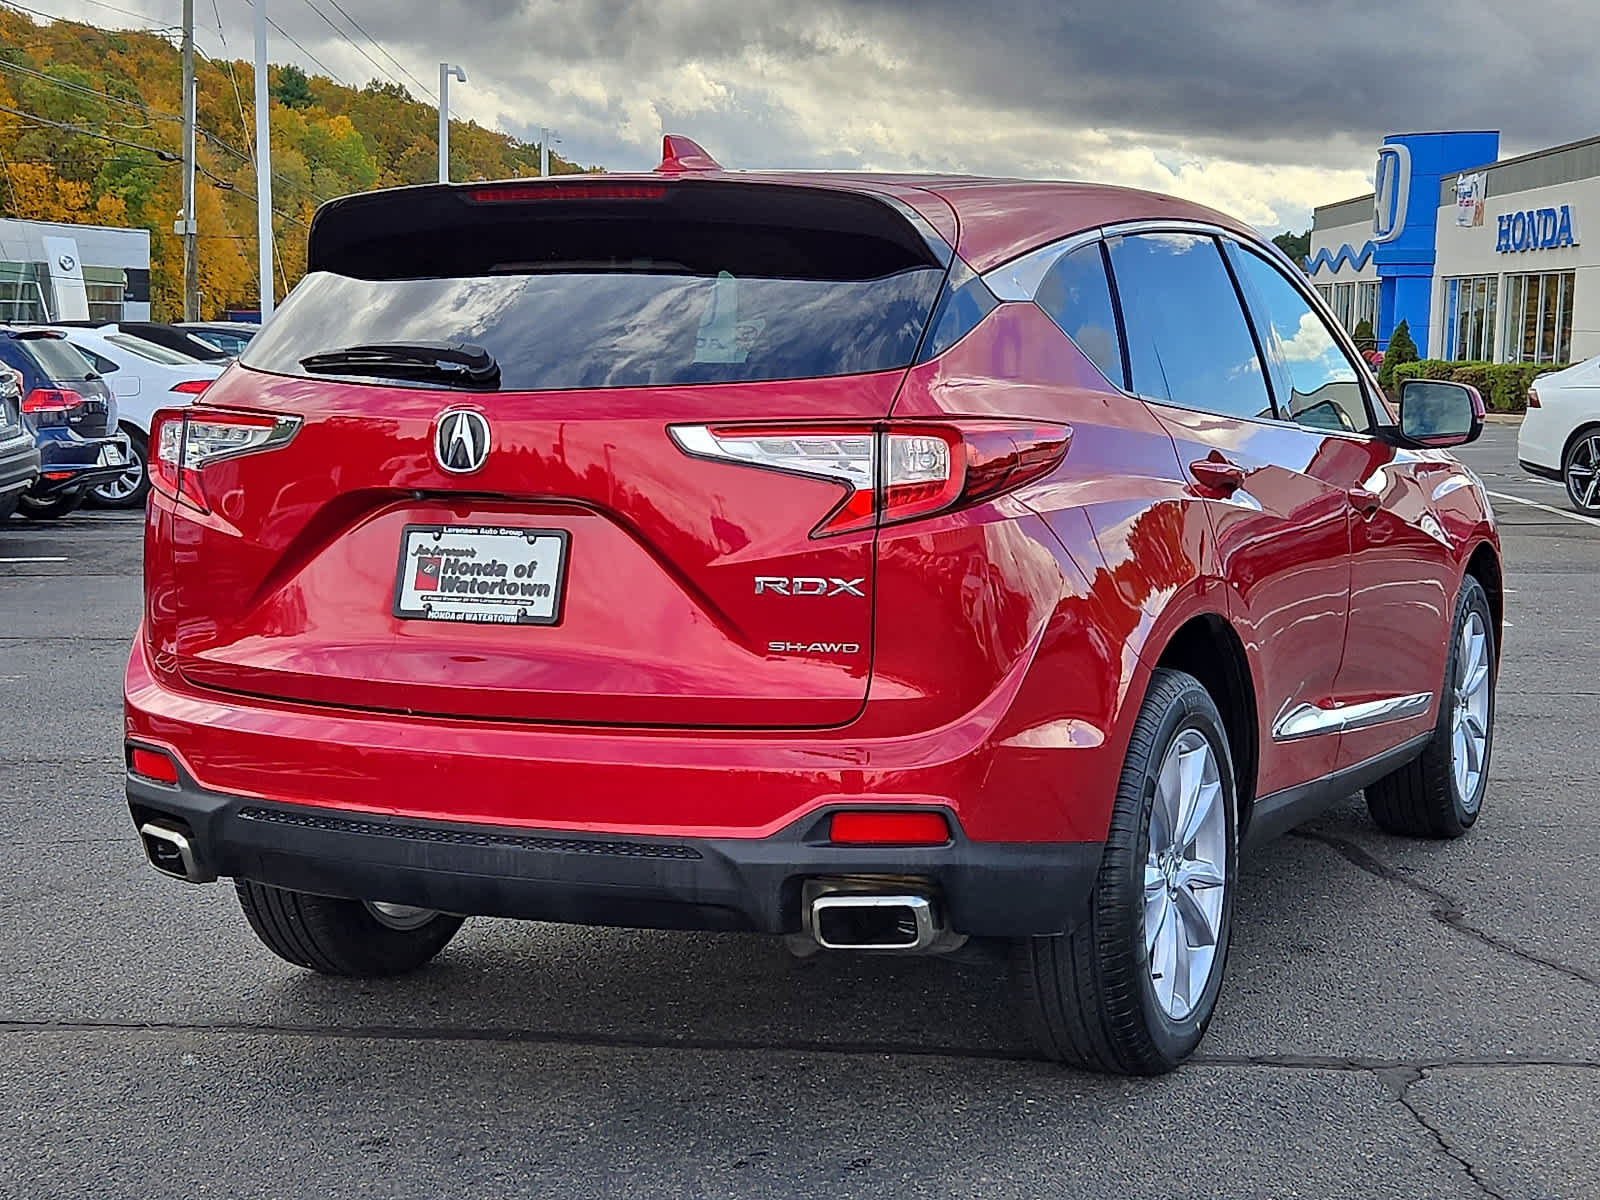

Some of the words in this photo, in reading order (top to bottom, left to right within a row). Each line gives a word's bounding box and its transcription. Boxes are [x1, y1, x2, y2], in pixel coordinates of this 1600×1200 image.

[1495, 204, 1576, 253] HONDA
[480, 527, 498, 536] Auto
[499, 528, 524, 538] Group
[442, 557, 508, 578] Honda
[514, 560, 538, 578] of
[440, 575, 551, 597] Watertown
[754, 576, 865, 597] RDX
[427, 610, 455, 620] HONDA
[465, 612, 517, 623] WATERTOWN
[768, 641, 860, 653] SH-AWD
